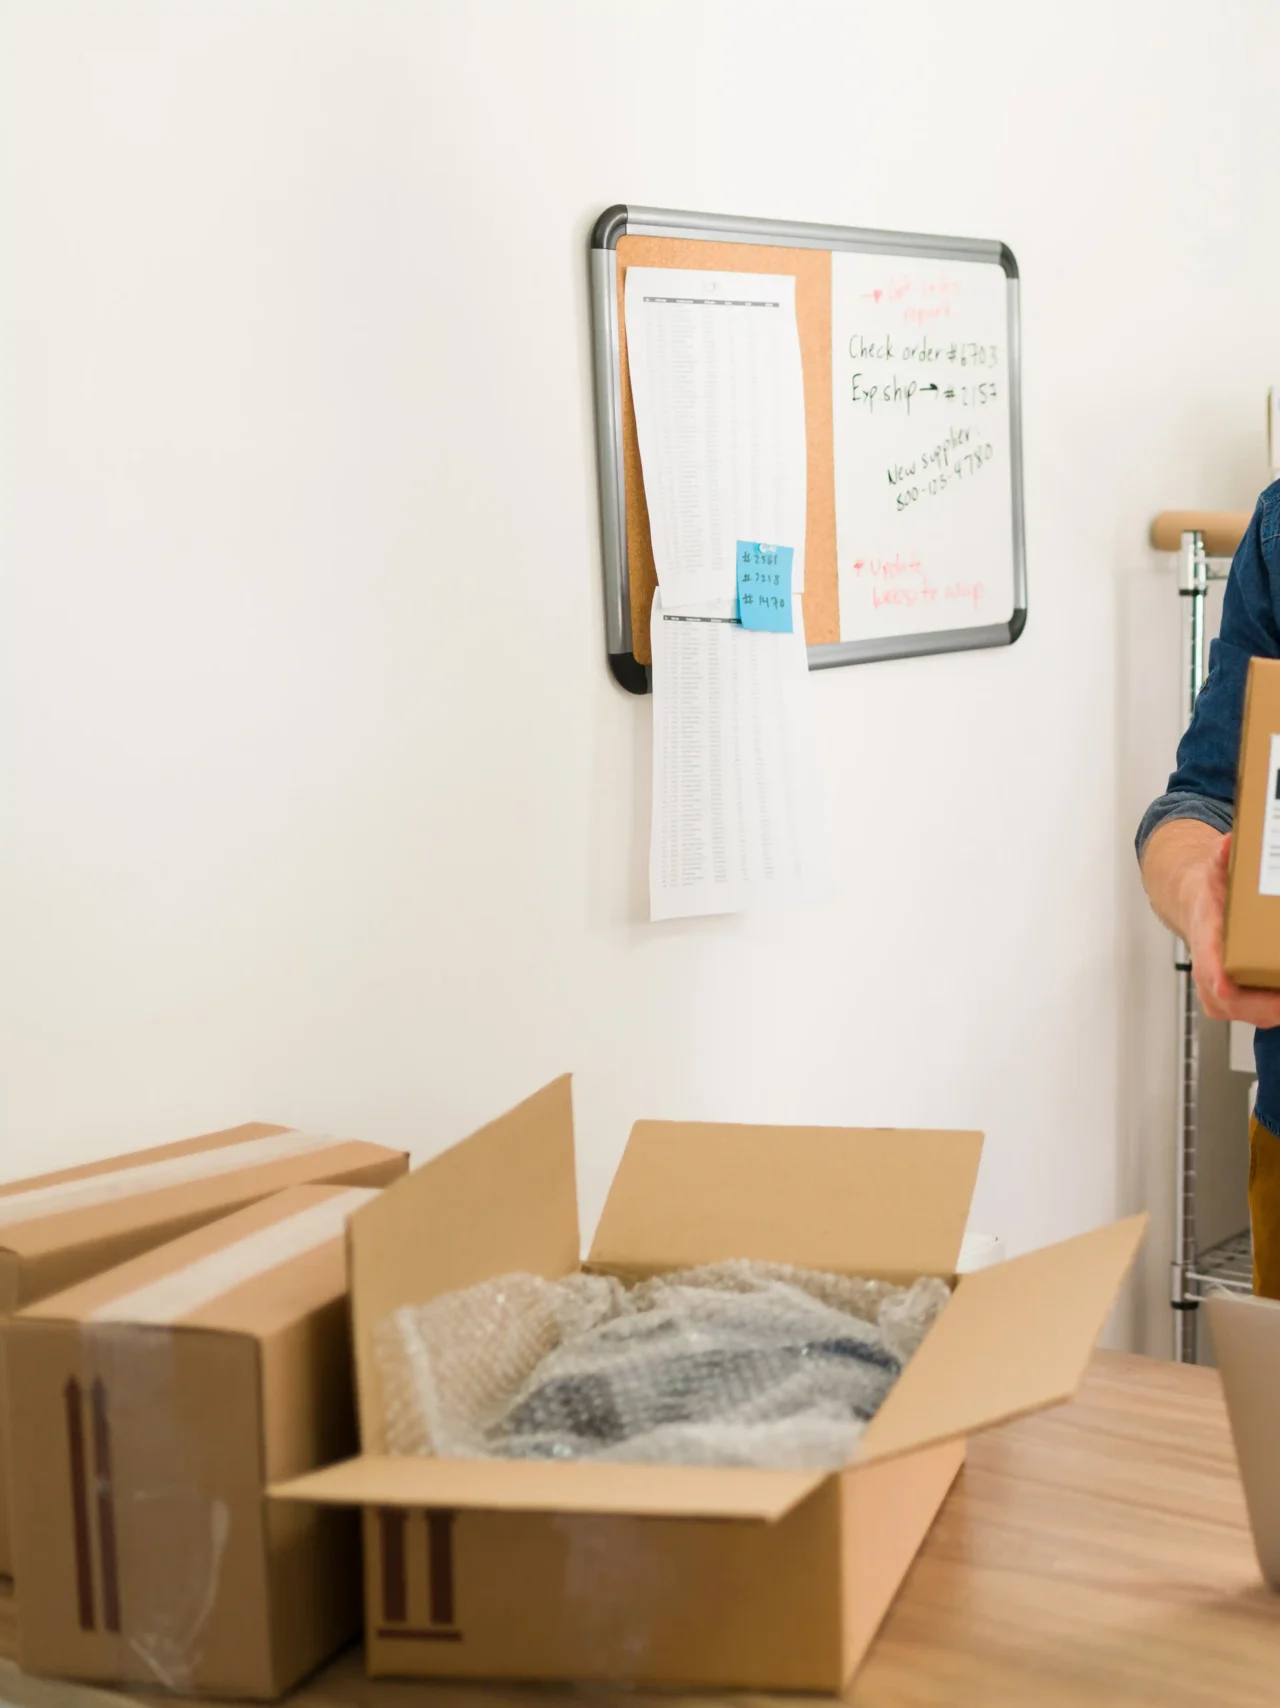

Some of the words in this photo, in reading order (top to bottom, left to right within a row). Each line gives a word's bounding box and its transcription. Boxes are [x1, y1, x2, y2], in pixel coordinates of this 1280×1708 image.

[849, 333, 895, 361] Check
[902, 335, 943, 362] order
[886, 462, 916, 485] New
